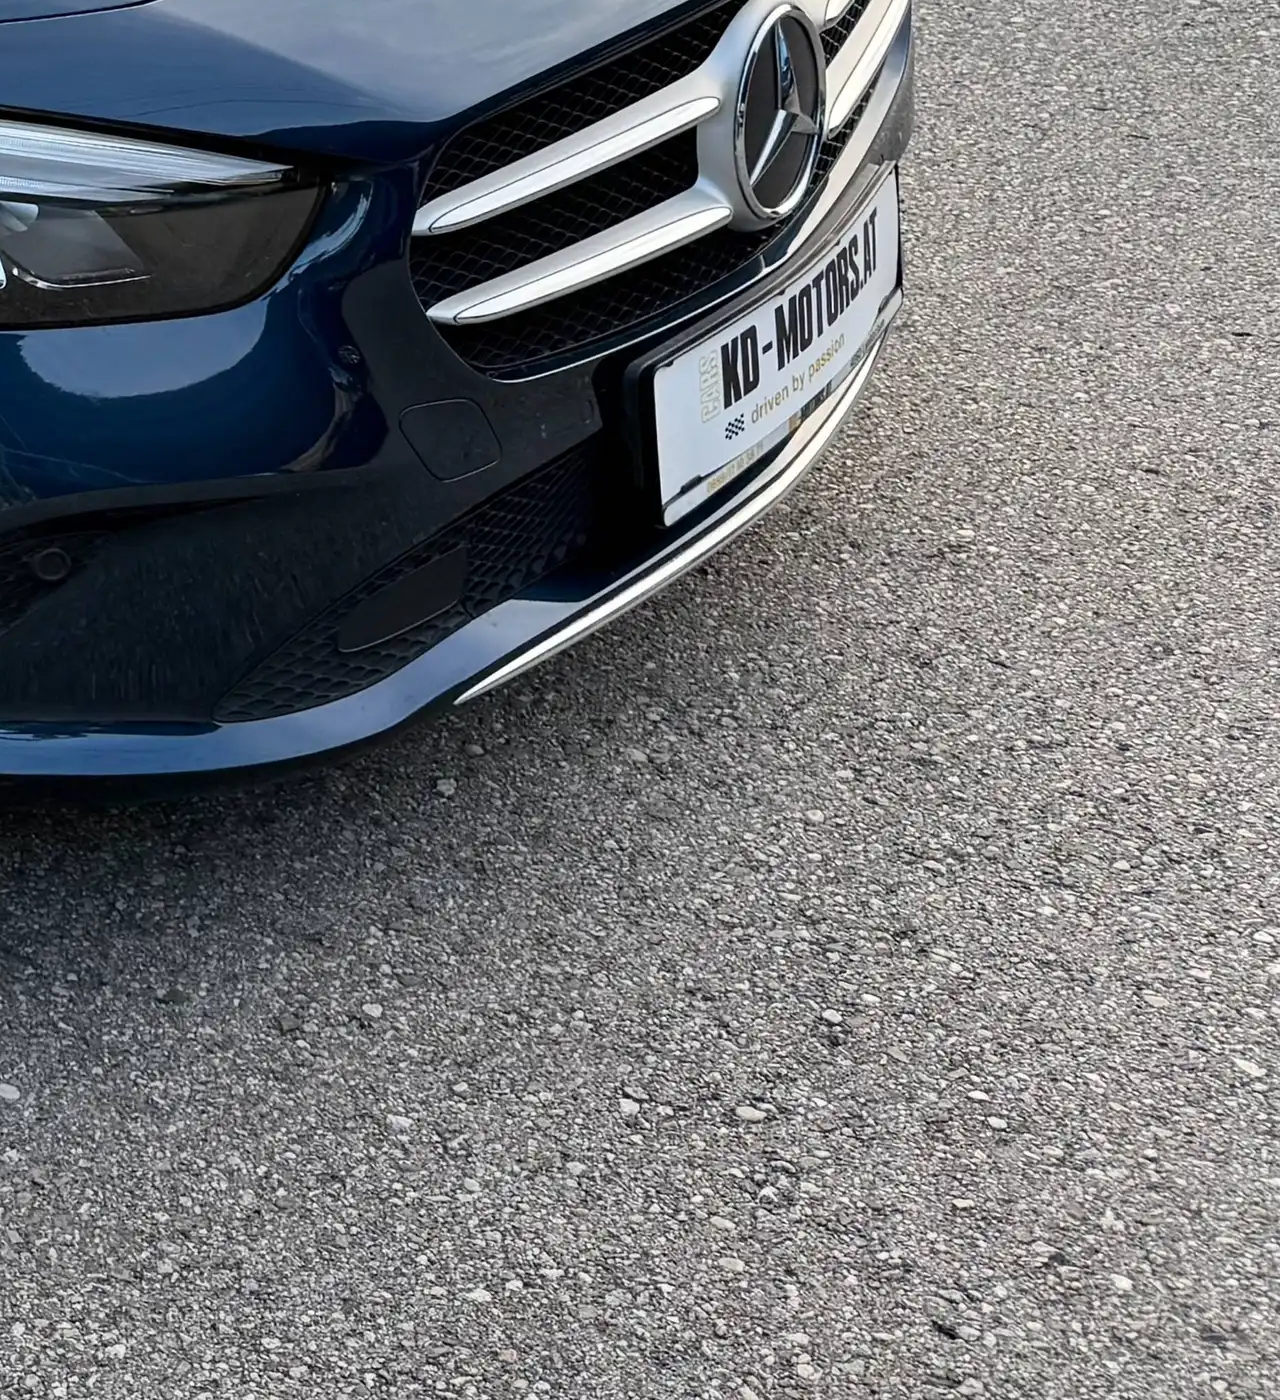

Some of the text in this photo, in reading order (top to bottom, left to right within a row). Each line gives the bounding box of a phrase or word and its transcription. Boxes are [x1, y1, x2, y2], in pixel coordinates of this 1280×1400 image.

[721, 207, 878, 410] KD-MOTORS.AT
[751, 386, 789, 424] driven
[792, 373, 805, 392] by
[808, 333, 845, 382] passion
